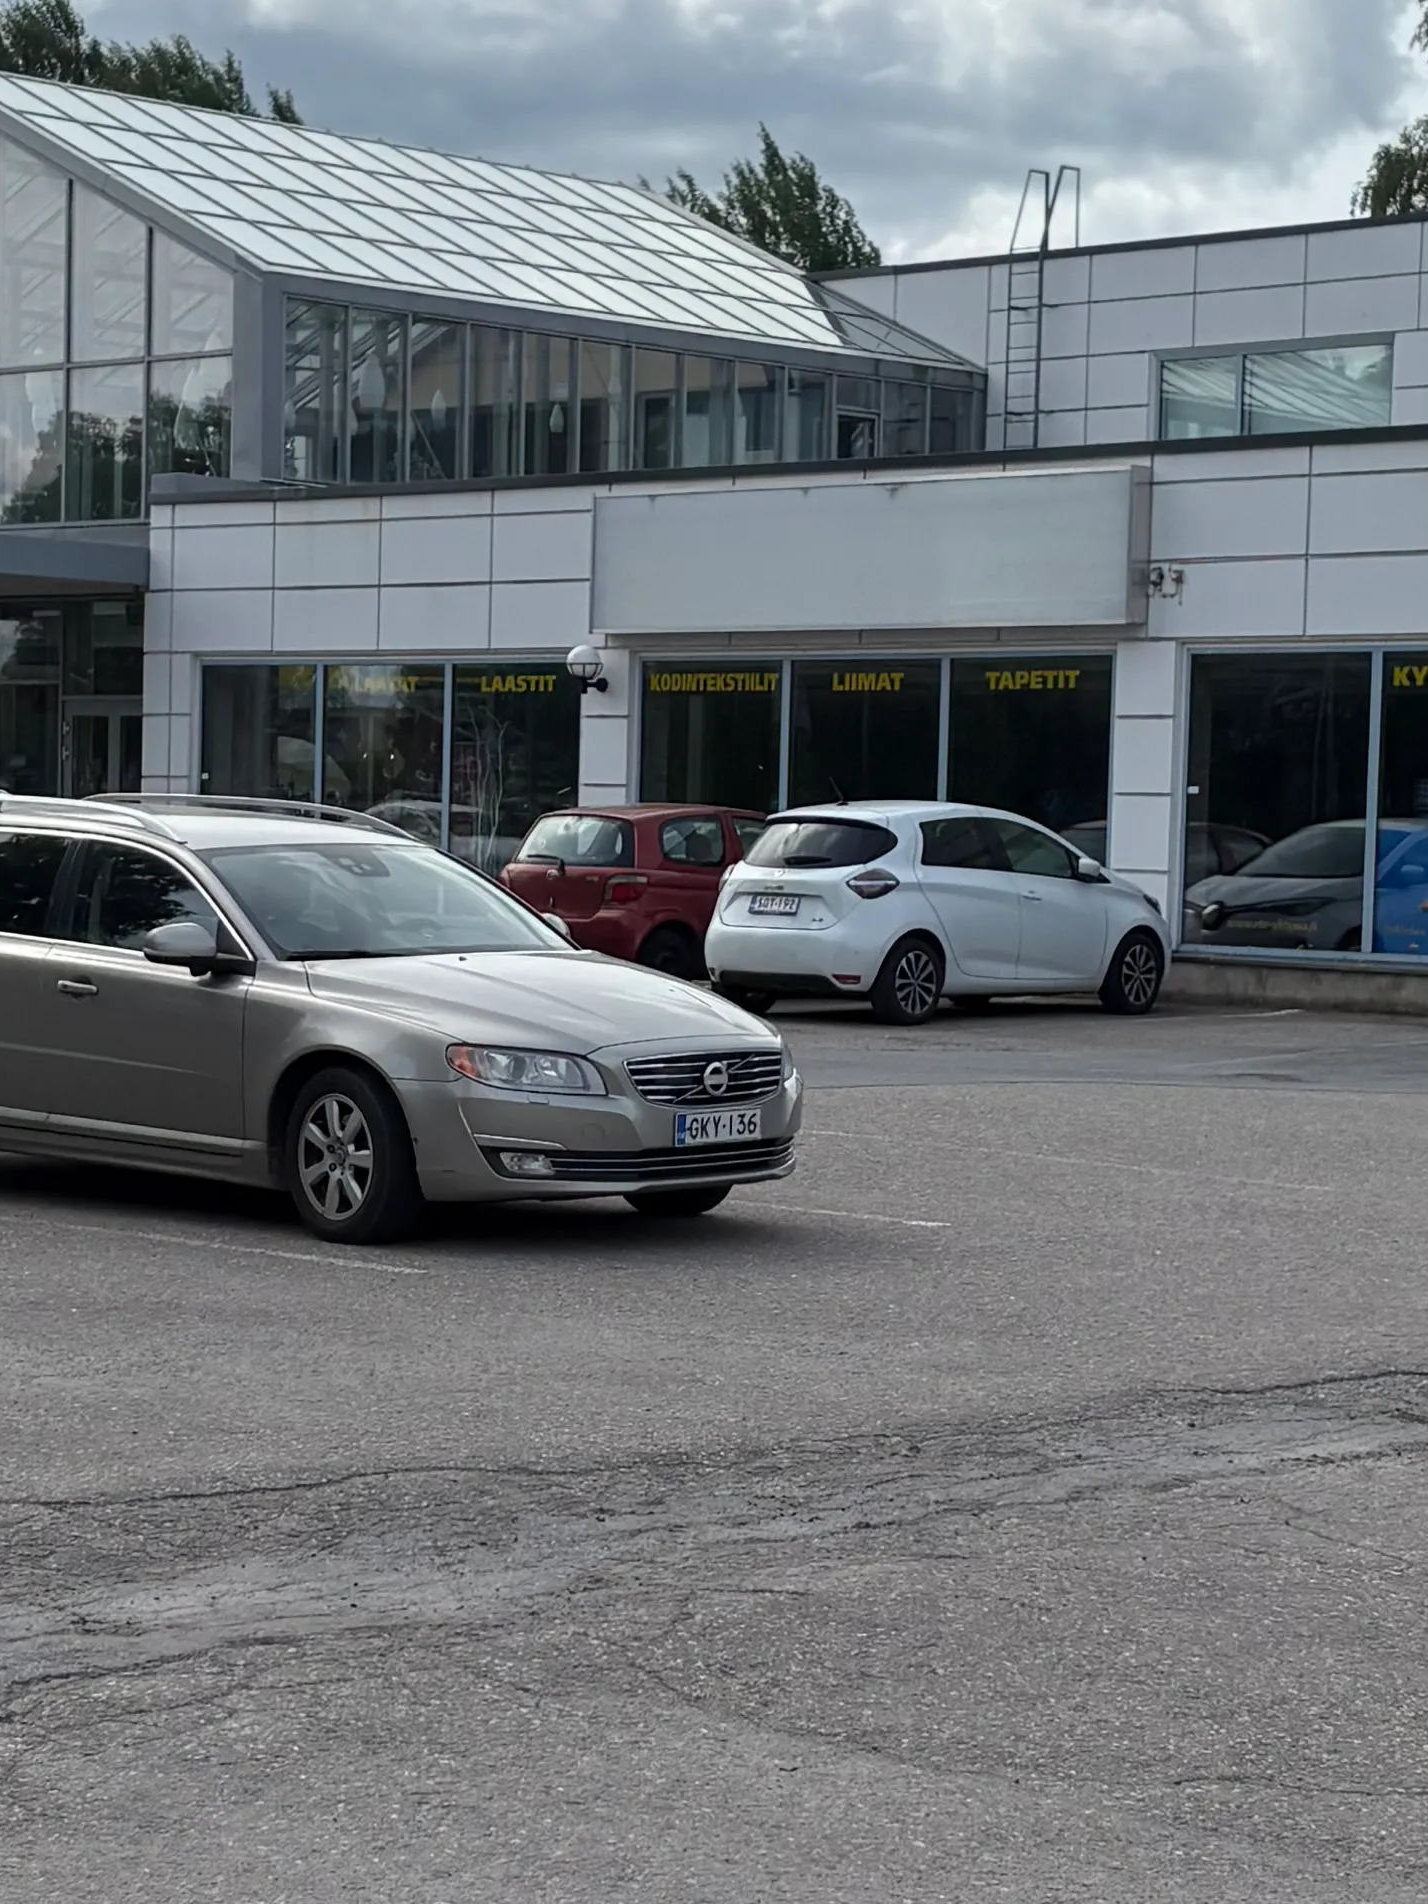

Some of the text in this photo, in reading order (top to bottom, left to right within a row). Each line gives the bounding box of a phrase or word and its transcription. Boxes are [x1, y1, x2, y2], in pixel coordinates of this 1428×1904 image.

[480, 675, 557, 693] LAASTIT
[649, 672, 779, 692] KODINTEKSTIILIT
[831, 672, 905, 692] LIIMAT
[985, 669, 1080, 690] TAPETIT
[689, 1113, 758, 1140] GKY-136
